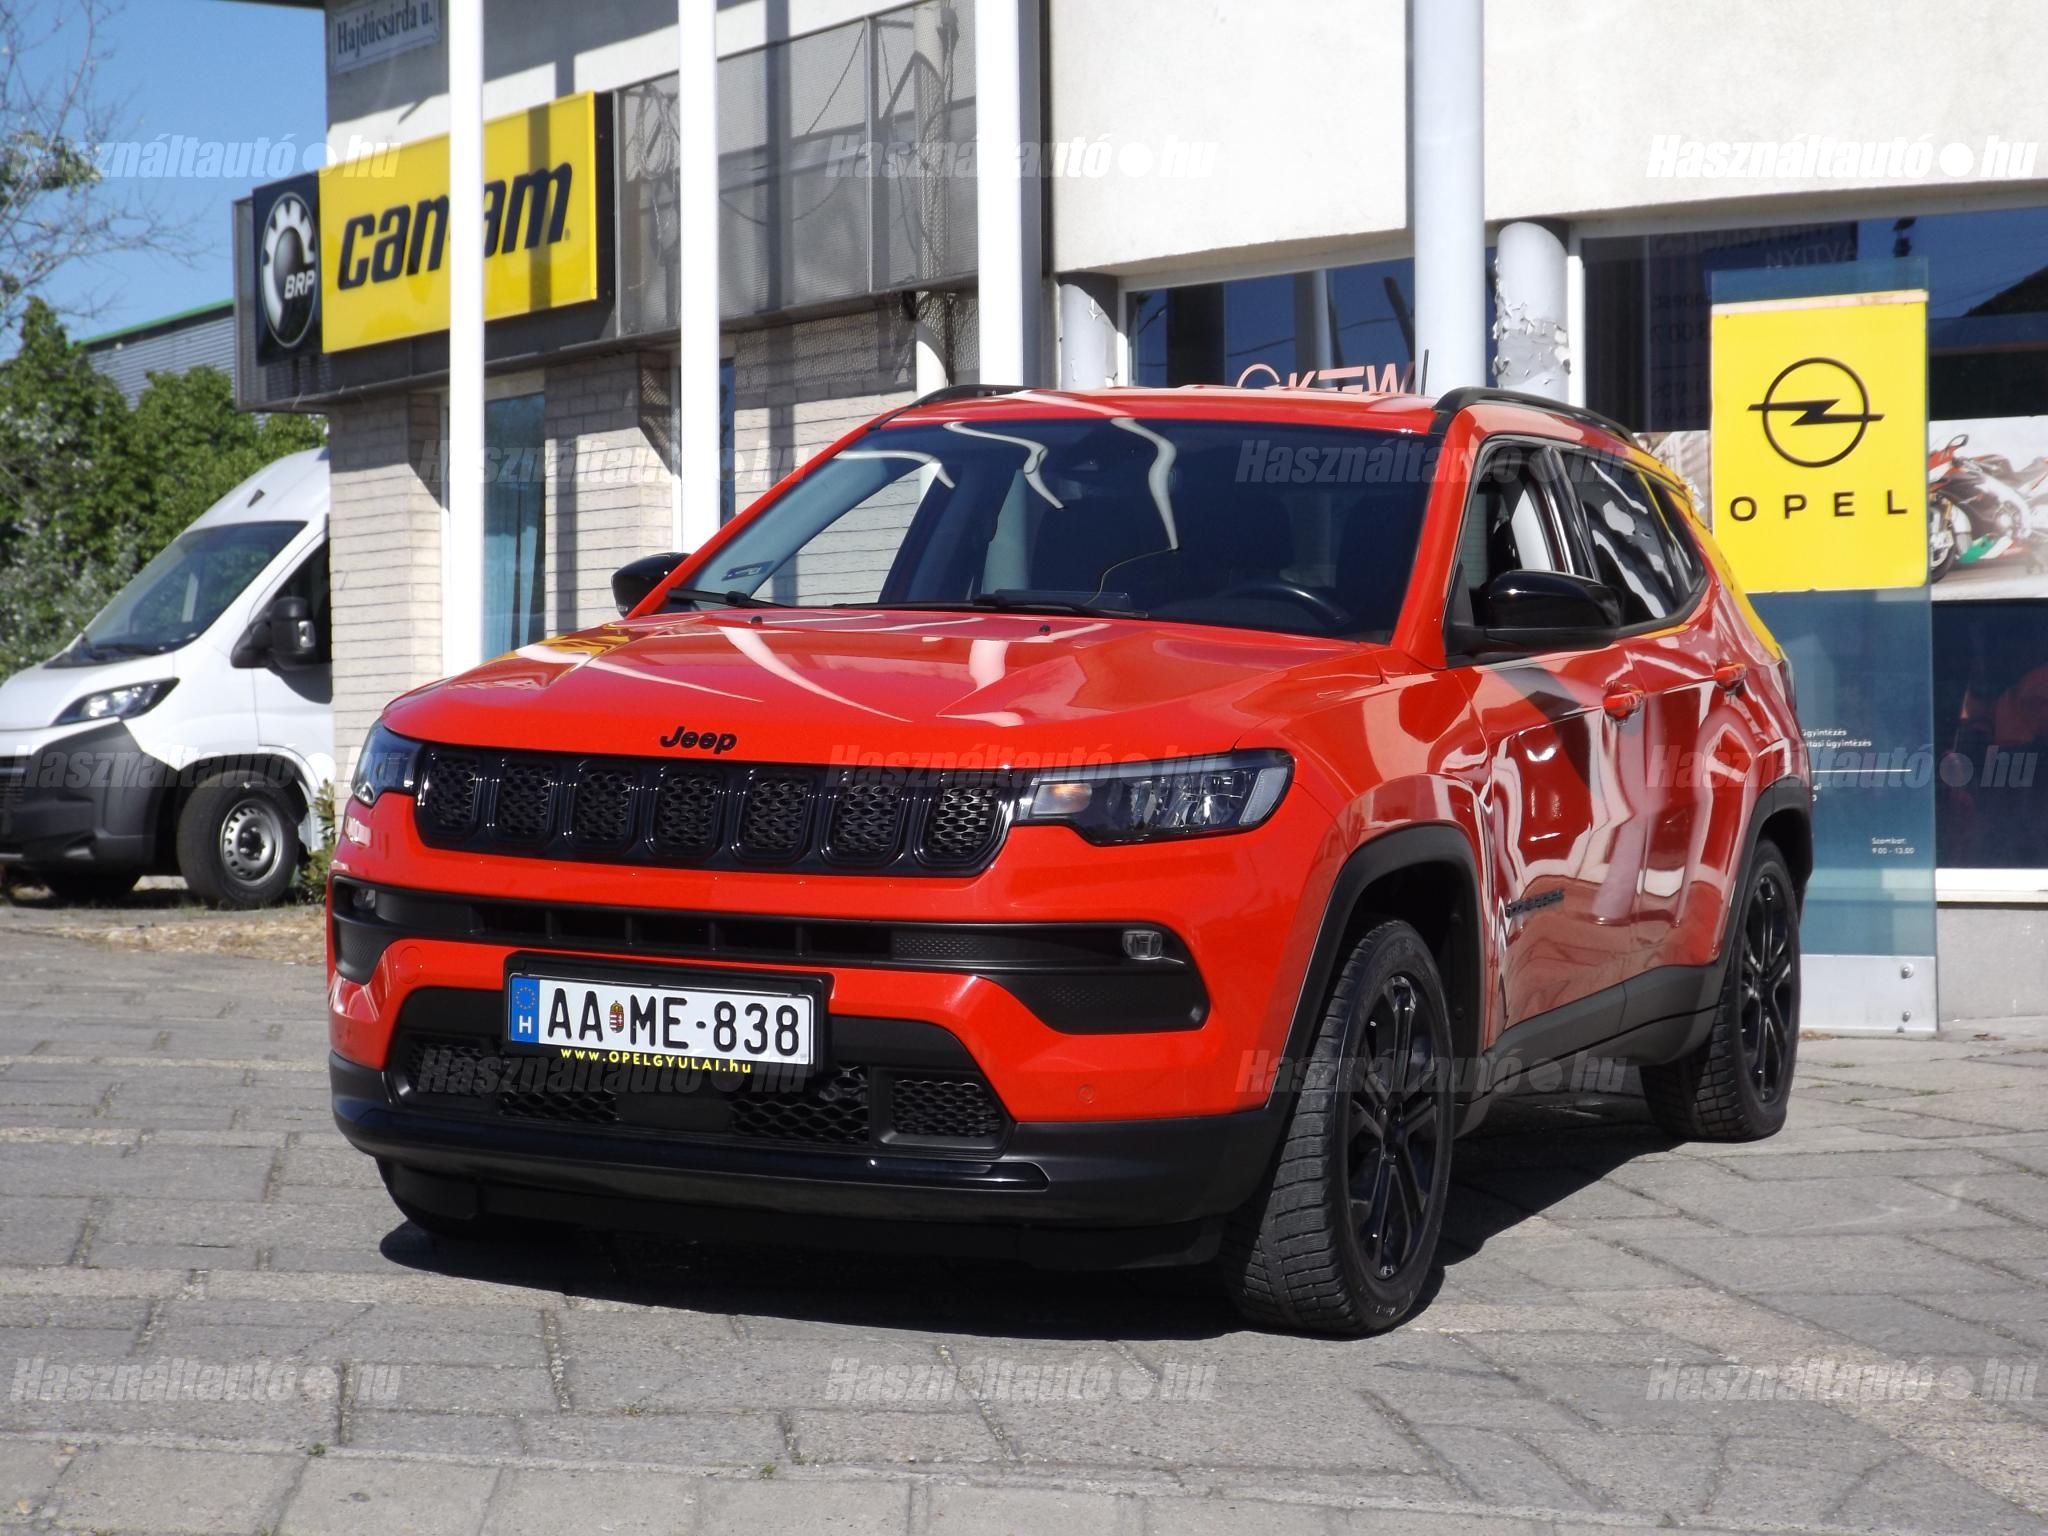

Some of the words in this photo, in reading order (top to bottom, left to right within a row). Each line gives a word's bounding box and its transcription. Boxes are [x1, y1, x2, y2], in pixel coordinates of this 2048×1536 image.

[284, 269, 315, 299] BRP
[1730, 490, 1908, 521] OPEL
[660, 726, 737, 755] Jeep
[519, 1015, 532, 1034] H
